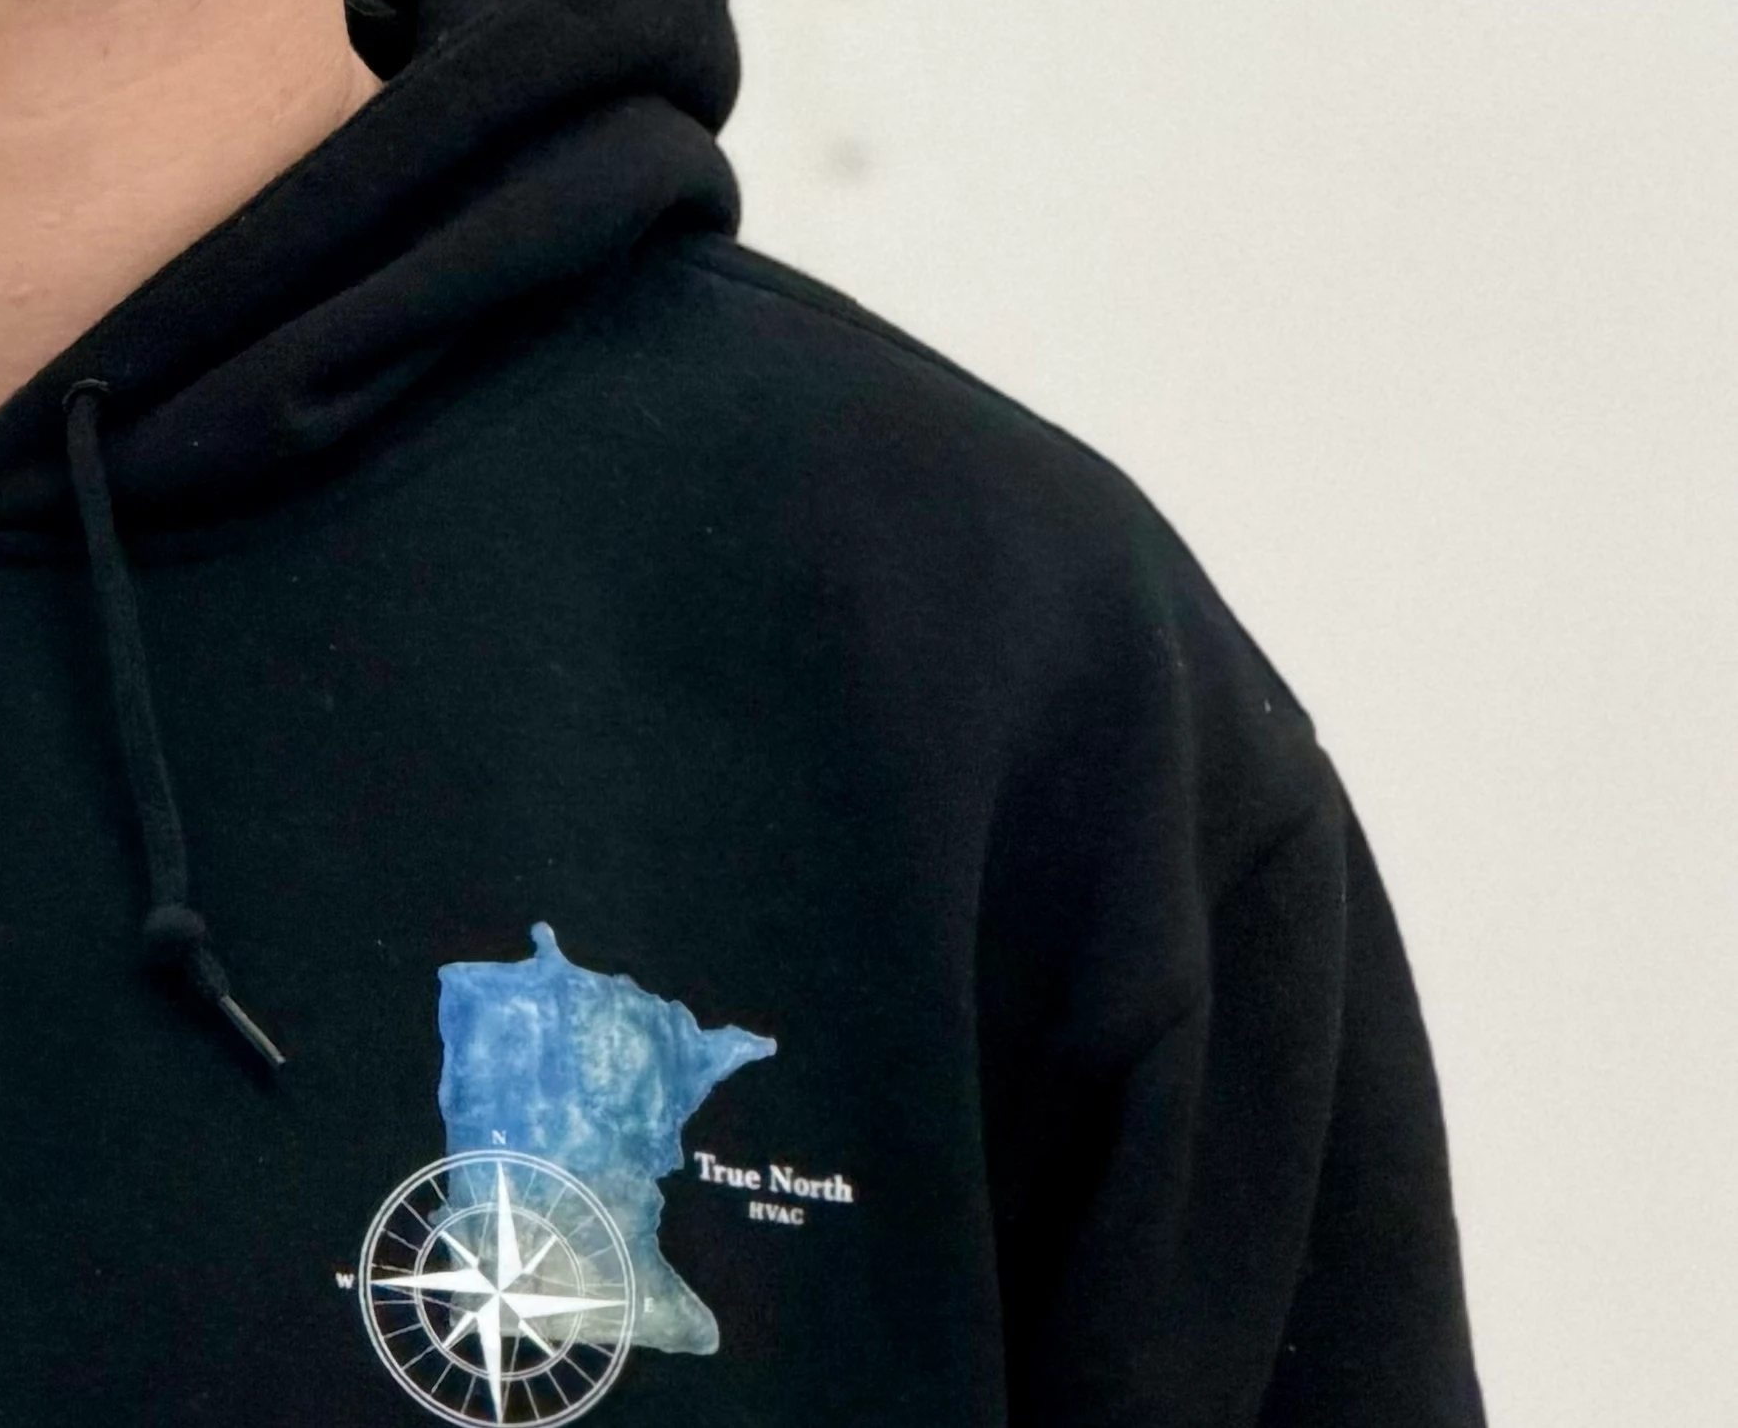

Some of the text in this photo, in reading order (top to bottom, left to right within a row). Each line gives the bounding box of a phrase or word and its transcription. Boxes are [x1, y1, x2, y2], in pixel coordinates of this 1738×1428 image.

[491, 1128, 508, 1146] N
[693, 1150, 855, 1204] True North
[748, 1200, 806, 1226] HVAC
[335, 1271, 355, 1290] W
[643, 1297, 655, 1313] E
